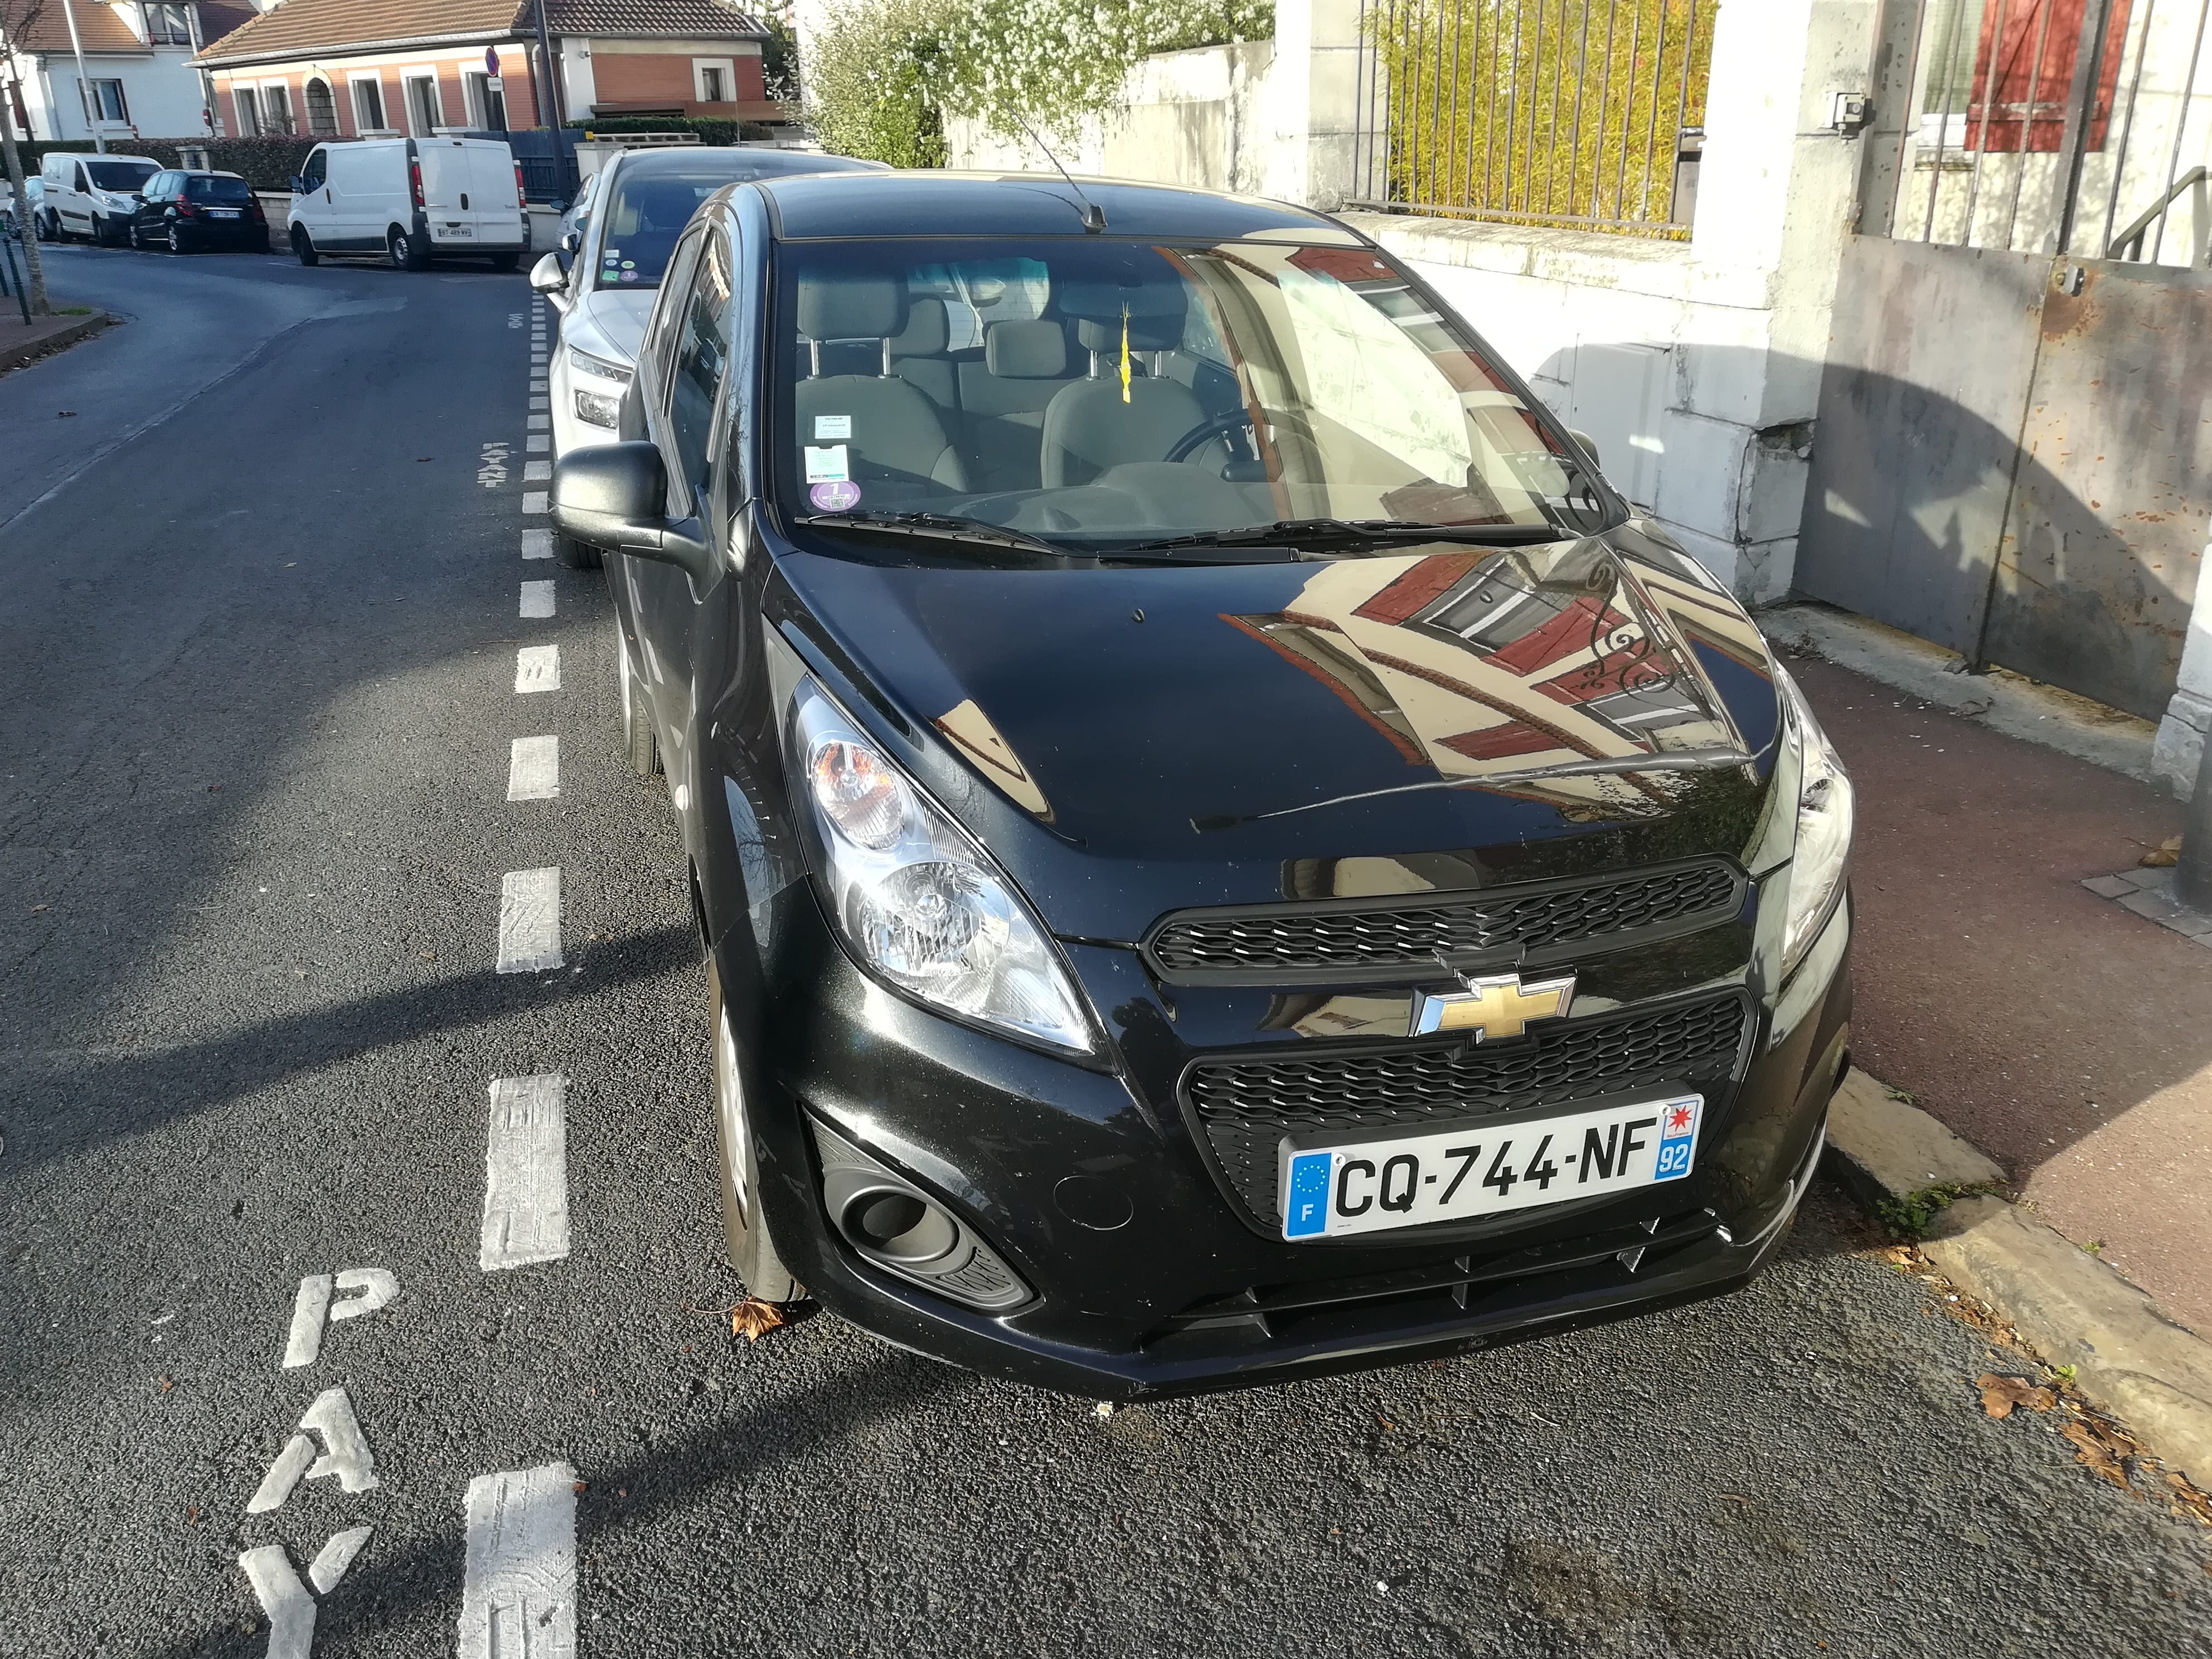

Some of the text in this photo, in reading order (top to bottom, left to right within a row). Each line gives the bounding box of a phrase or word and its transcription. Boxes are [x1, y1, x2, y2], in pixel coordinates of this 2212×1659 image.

[830, 483, 839, 495] 1
[1335, 1117, 1658, 1218] CQ-744-NF
[1659, 1143, 1689, 1173] 92
[1301, 1203, 1314, 1222] F
